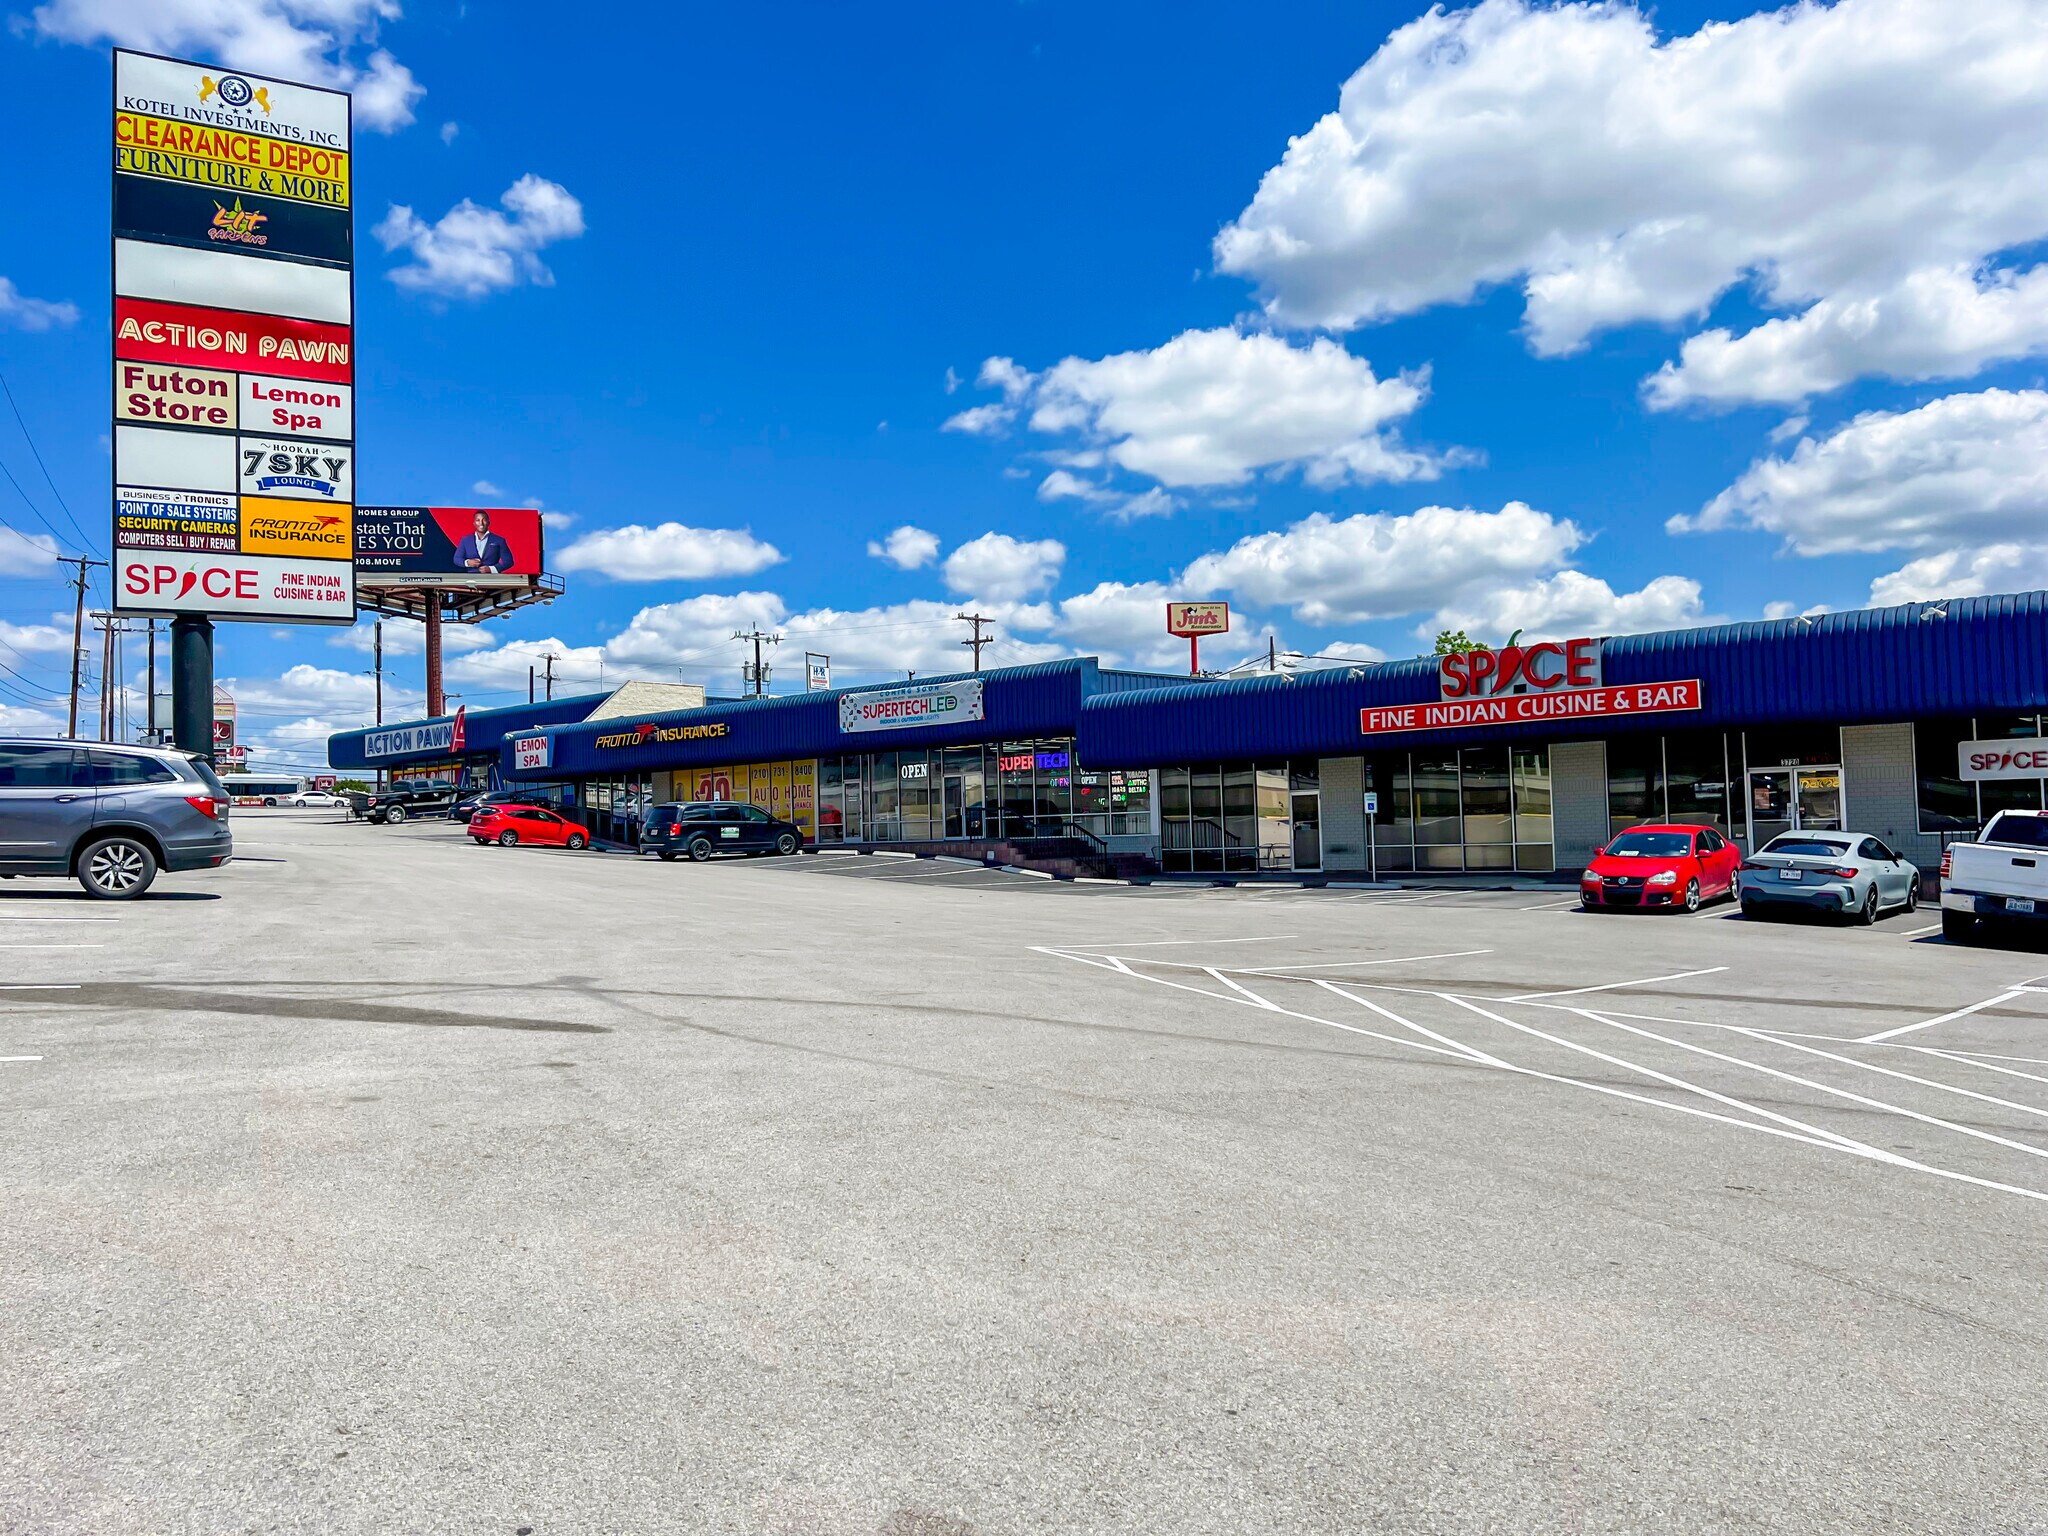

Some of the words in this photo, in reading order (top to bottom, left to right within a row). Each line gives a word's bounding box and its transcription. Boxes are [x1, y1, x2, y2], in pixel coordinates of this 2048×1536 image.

[123, 96, 179, 117] KOTEL
[184, 106, 306, 142] INVESTMENTS,
[309, 129, 342, 147] INC.
[115, 115, 262, 164] CLEARANCE
[269, 142, 343, 178] DEPOT
[115, 147, 252, 189] FURNITURE
[258, 170, 273, 191] &
[280, 174, 346, 204] MORE
[212, 206, 268, 232] LIT
[207, 228, 268, 245] GARDENS
[118, 317, 247, 355] ACTION
[259, 335, 348, 365] PAWN
[123, 366, 228, 397] Futon
[252, 382, 341, 408] Lemon
[127, 393, 228, 424] Store
[272, 408, 322, 431] Spa
[273, 444, 319, 455] HOOKAH
[274, 477, 318, 488] LOUNGE
[123, 491, 171, 501] BUSINESS
[183, 494, 229, 505] TRONICS
[119, 501, 149, 515] POINT
[151, 503, 165, 516] OF
[167, 505, 191, 518] SALE
[193, 507, 237, 521] SYSTEMS
[118, 516, 178, 531] SECURITY
[181, 520, 237, 535] CAMERAS
[250, 518, 321, 531] PRONTO
[356, 523, 391, 535] state
[393, 521, 426, 535] That
[118, 531, 165, 546] COMPUTERS
[166, 534, 185, 547] SELL
[189, 536, 205, 548] BUY
[210, 537, 236, 550] REPAIR
[249, 529, 346, 544] INSURANCE
[358, 536, 377, 549] ES
[383, 536, 423, 550] YOU
[281, 573, 305, 586] FINE
[306, 574, 341, 588] INDIAN
[273, 589, 314, 601] CUISINE
[316, 590, 323, 601] &
[325, 591, 346, 602] BAR
[1176, 608, 1218, 628] Jim's
[879, 686, 912, 697] COMING
[916, 685, 940, 695] SOON
[863, 695, 958, 719] SUPERTECHLED
[1369, 708, 1416, 729] FINE
[1425, 701, 1506, 725] INDIAN
[1517, 692, 1607, 717] CUISINE
[1613, 691, 1630, 708] &
[1637, 685, 1688, 707] BAR
[879, 717, 897, 725] INDOOR
[901, 715, 924, 723] OUTDOOR
[366, 731, 412, 755] ACTION
[417, 725, 453, 749] PAWN
[595, 731, 641, 749] PRONTO
[655, 723, 726, 742] INSURANCE
[516, 737, 547, 753] LEMON
[523, 754, 541, 768] SPA
[1000, 755, 1034, 772] SUPER
[1036, 752, 1069, 769] TECH
[751, 768, 770, 781] (210)
[794, 764, 813, 776] 8400
[901, 763, 928, 779] OPEN
